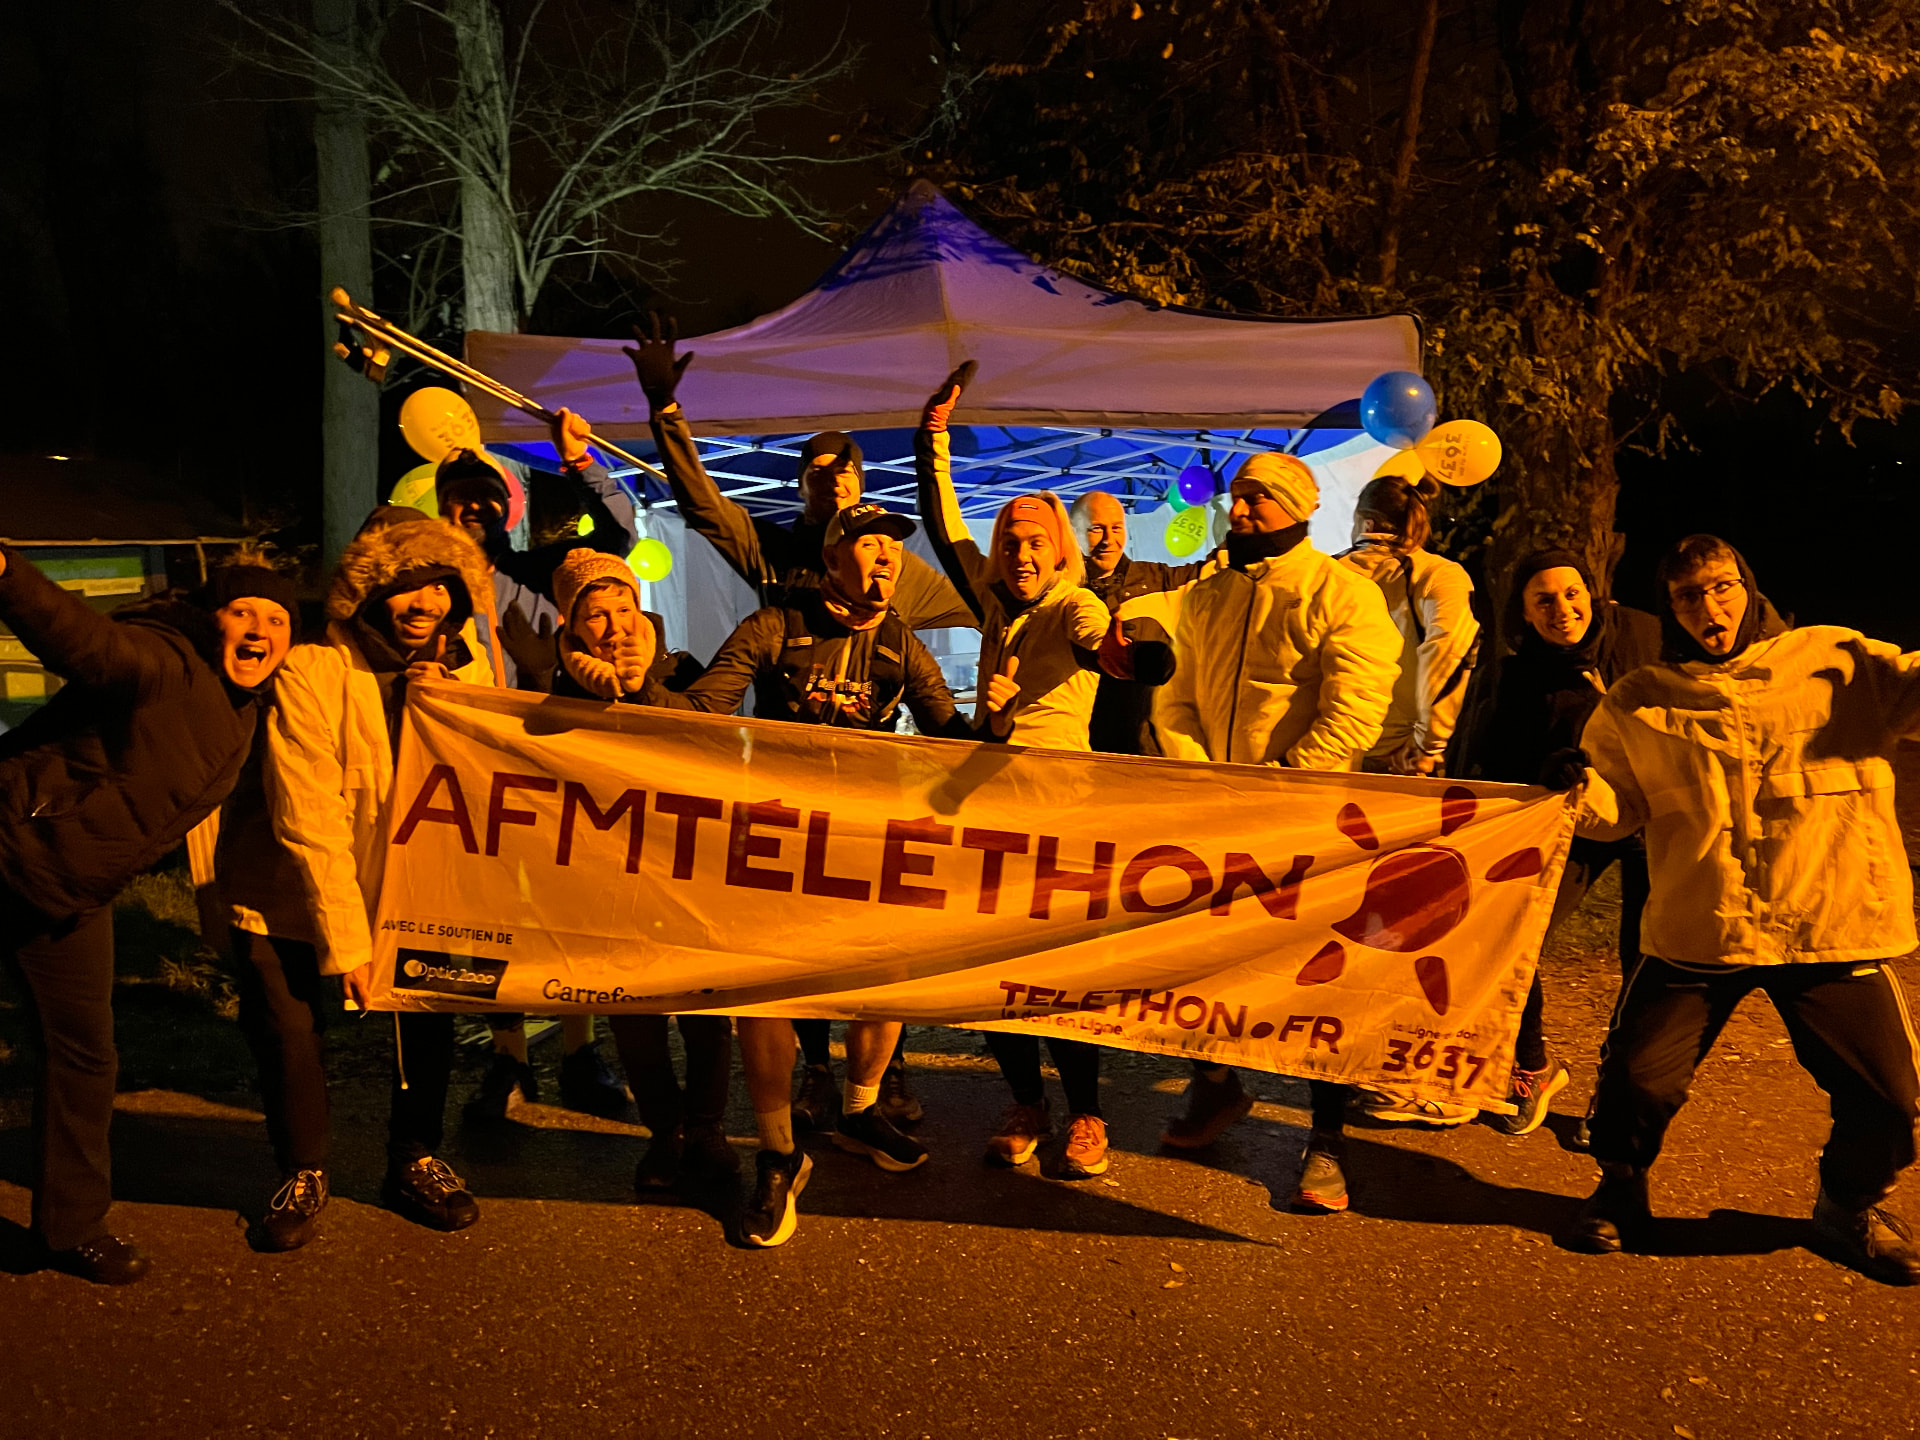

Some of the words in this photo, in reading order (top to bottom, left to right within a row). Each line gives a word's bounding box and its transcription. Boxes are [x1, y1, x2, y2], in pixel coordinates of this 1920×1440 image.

[381, 919, 416, 932] AVEC
[420, 922, 436, 935] LE
[438, 925, 493, 942] SOUTIEN
[496, 932, 513, 945] DE
[1382, 1038, 1489, 1089] 3637
